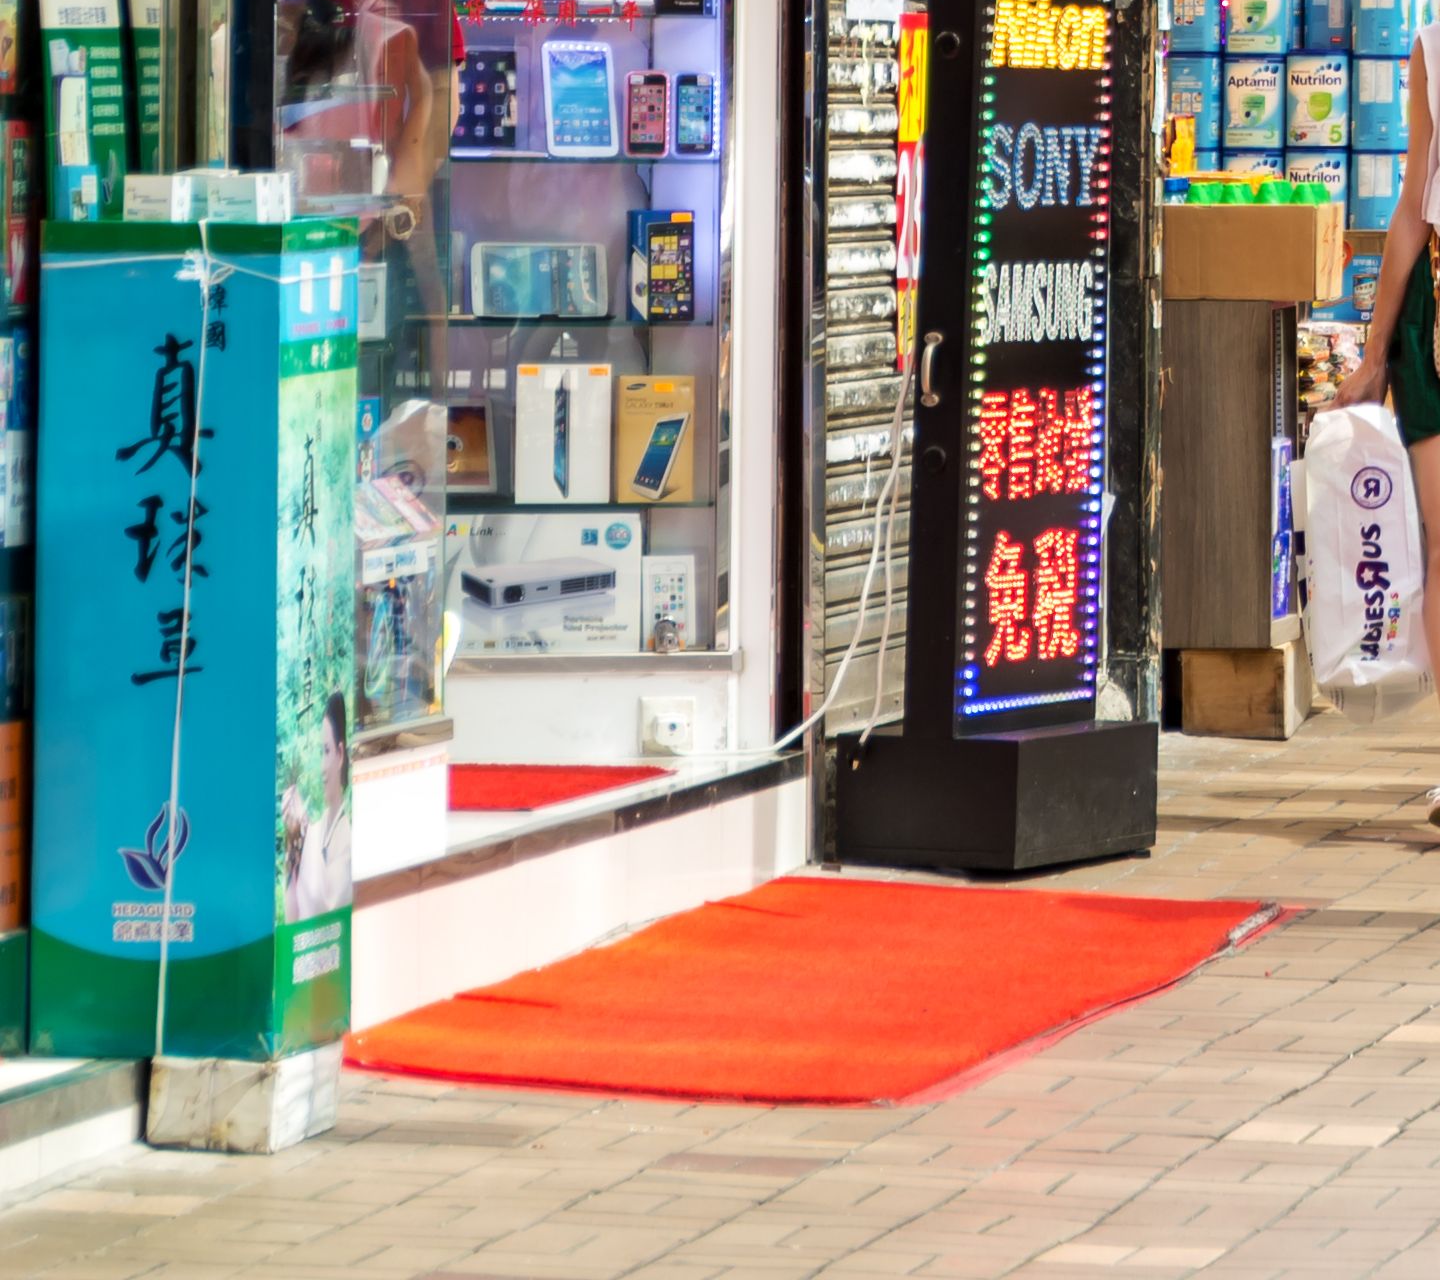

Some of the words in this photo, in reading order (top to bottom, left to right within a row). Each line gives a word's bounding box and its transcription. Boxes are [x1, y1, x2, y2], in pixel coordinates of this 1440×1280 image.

[1227, 76, 1278, 89] Aptamil
[1290, 74, 1343, 87] Nutrilon
[985, 121, 1105, 212] SONY
[1289, 171, 1341, 184] Nutrilon
[981, 256, 1094, 347] SAMSUNG
